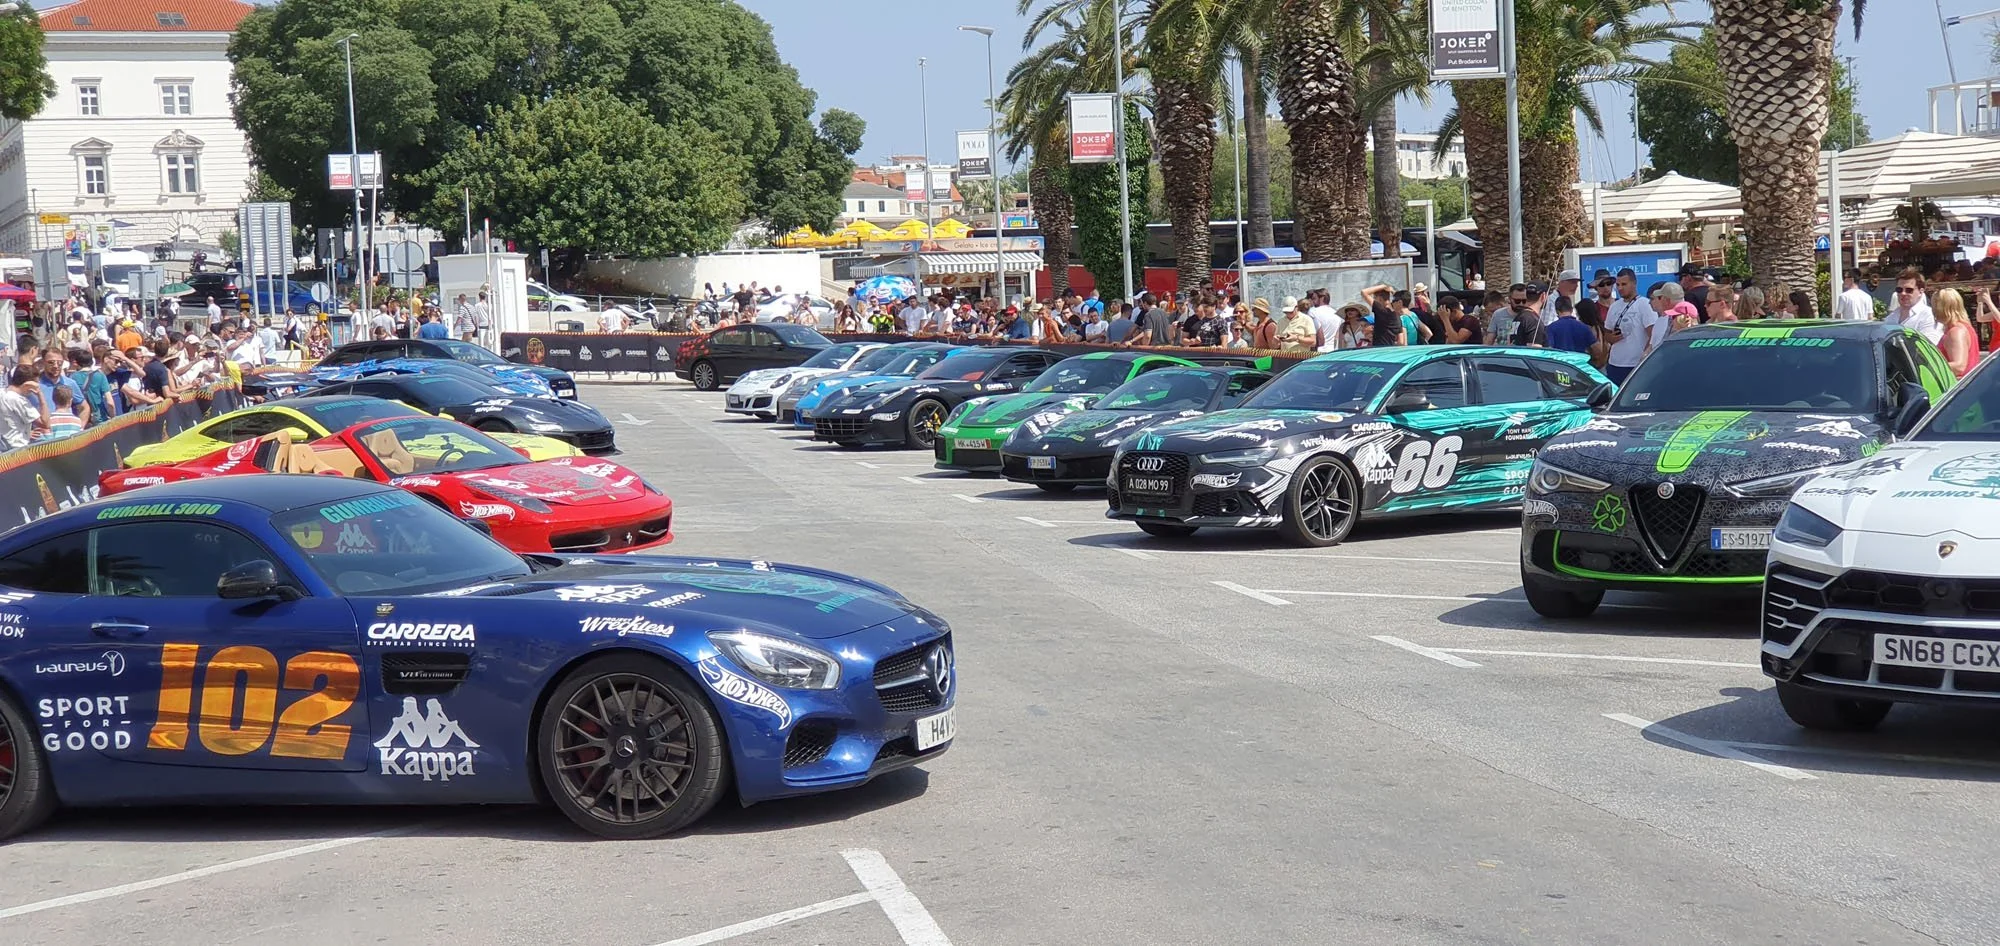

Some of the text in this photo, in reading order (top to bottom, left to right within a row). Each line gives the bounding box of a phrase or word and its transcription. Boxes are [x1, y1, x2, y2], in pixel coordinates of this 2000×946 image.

[1440, 37, 1486, 48] JOKER
[1076, 135, 1107, 144] JOKER
[1689, 338, 1835, 348] GUMBALL 3000
[1351, 422, 1394, 431] CARRERA
[1390, 436, 1463, 493] 66
[1201, 476, 1228, 488] WHEELS
[1365, 467, 1394, 484] Kappa
[1129, 479, 1169, 490] A 028 MO 99
[96, 503, 223, 520] GUMBALL 3000
[473, 504, 489, 519] HOT
[367, 623, 475, 640] CARRERA
[578, 615, 675, 637] Wreckless
[1885, 638, 2000, 668] SN68 CGX
[713, 671, 748, 698] HOT
[39, 696, 129, 718] SPORT
[146, 643, 360, 760] 102
[43, 731, 131, 751] GOOD
[379, 747, 476, 781] Kappa
